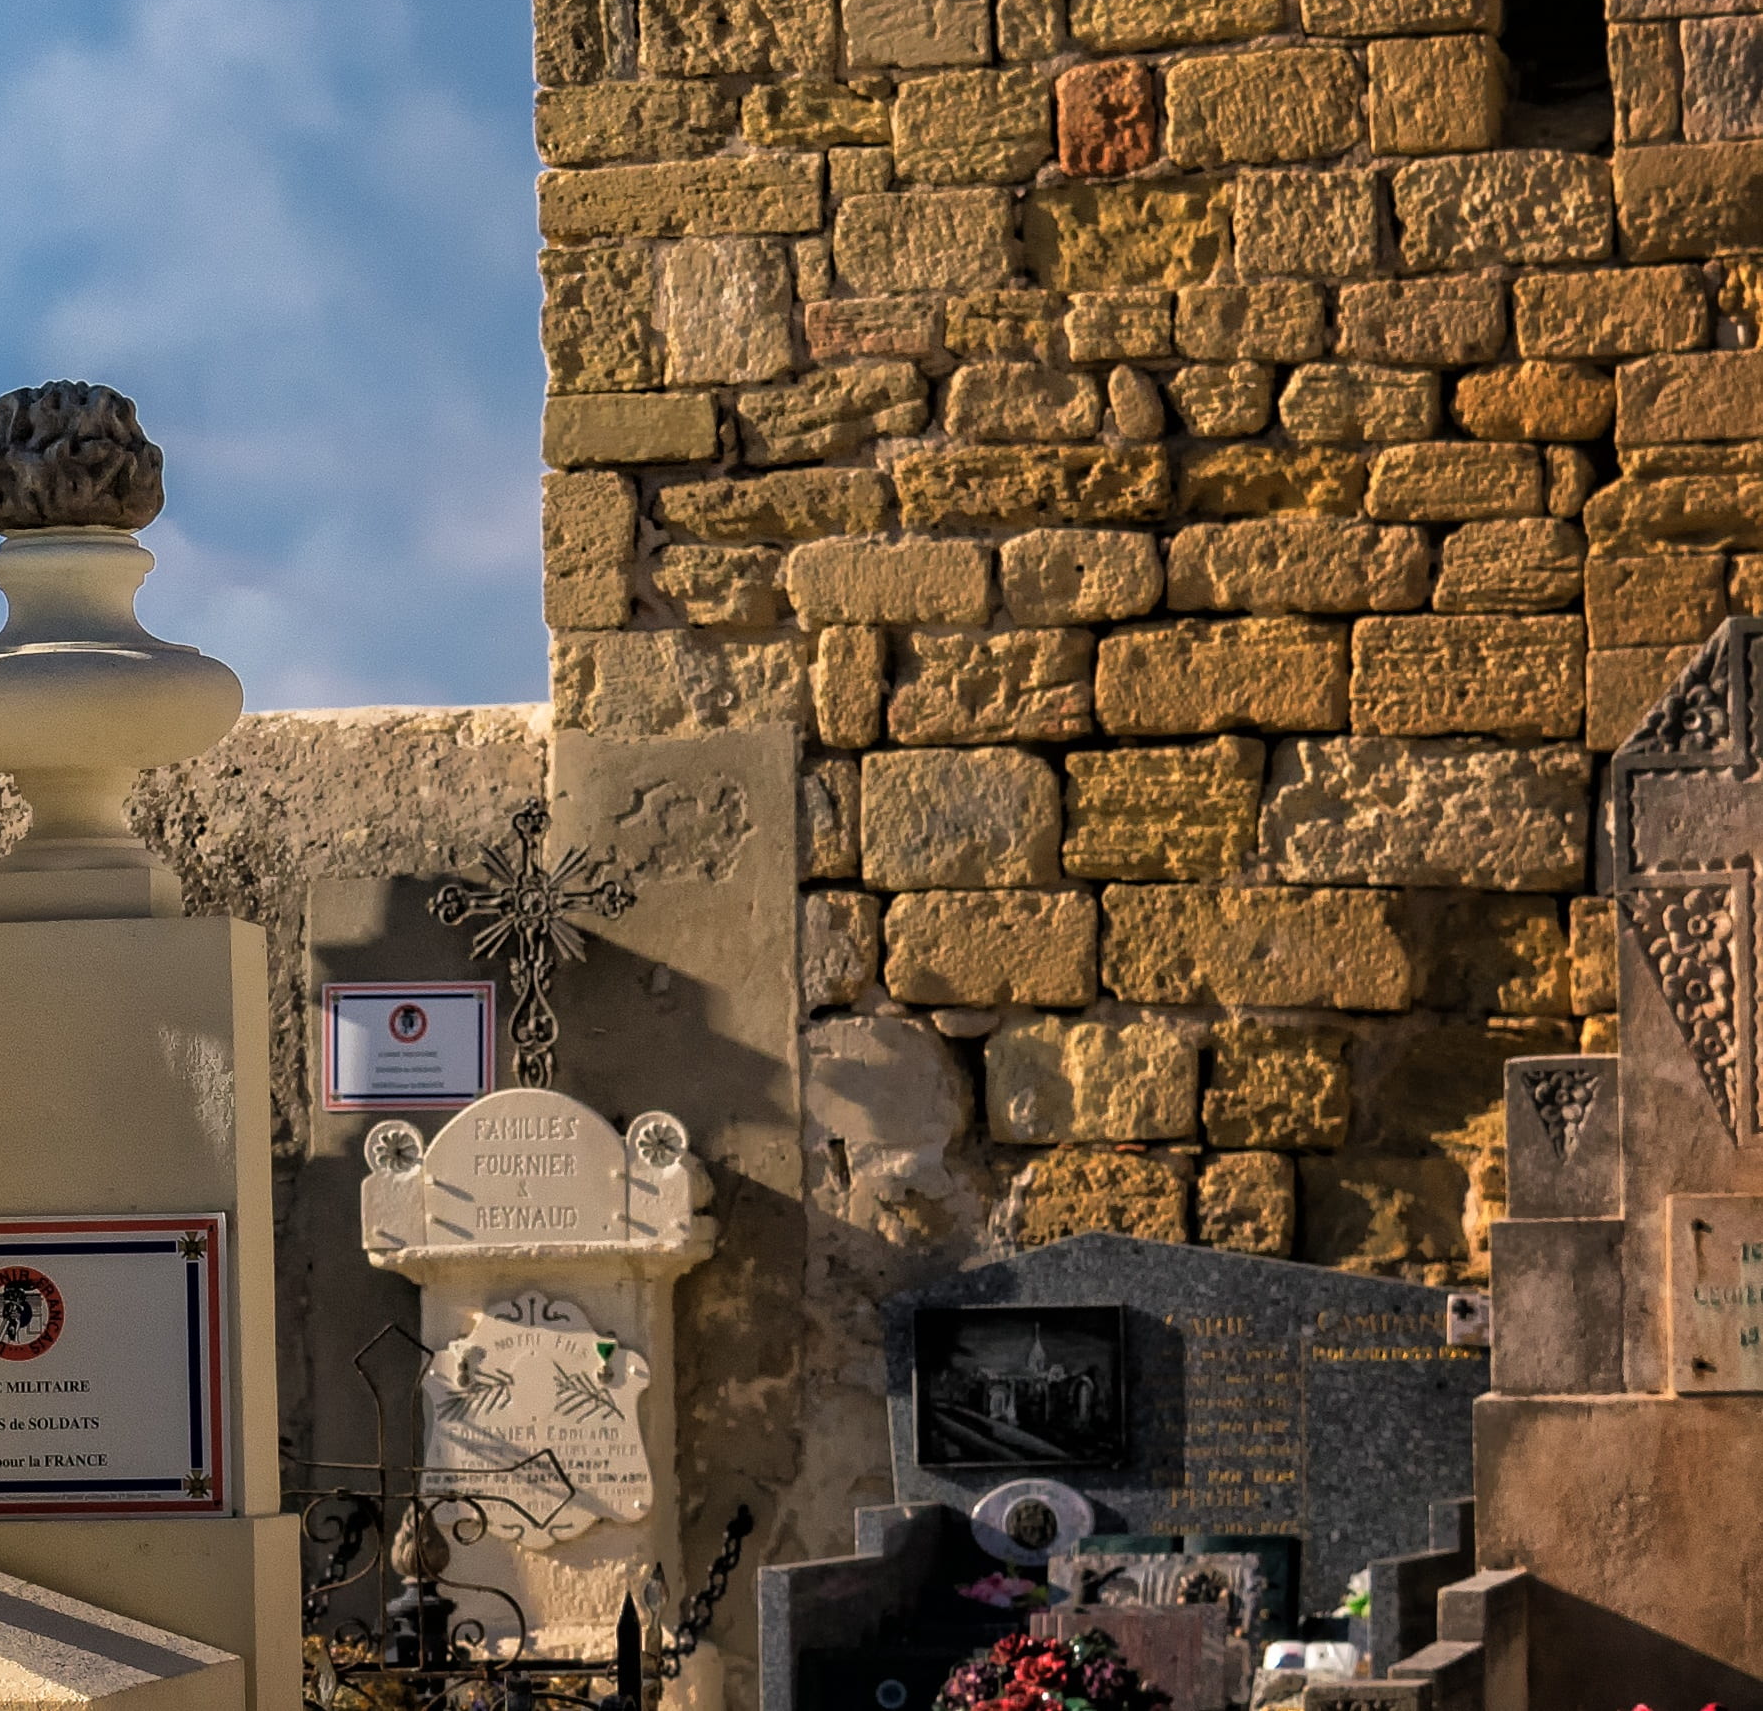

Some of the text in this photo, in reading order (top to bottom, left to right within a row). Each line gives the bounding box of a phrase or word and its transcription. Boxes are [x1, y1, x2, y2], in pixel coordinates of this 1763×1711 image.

[474, 1117, 579, 1140] FAMILLES
[474, 1153, 577, 1177] FOURNIER
[476, 1206, 578, 1230] REYNAUD
[7, 1380, 90, 1393] MILITAIRE
[10, 1418, 25, 1430] de
[28, 1417, 99, 1430] SOLDATS
[29, 1455, 41, 1467] la
[45, 1454, 107, 1467] FRANCE
